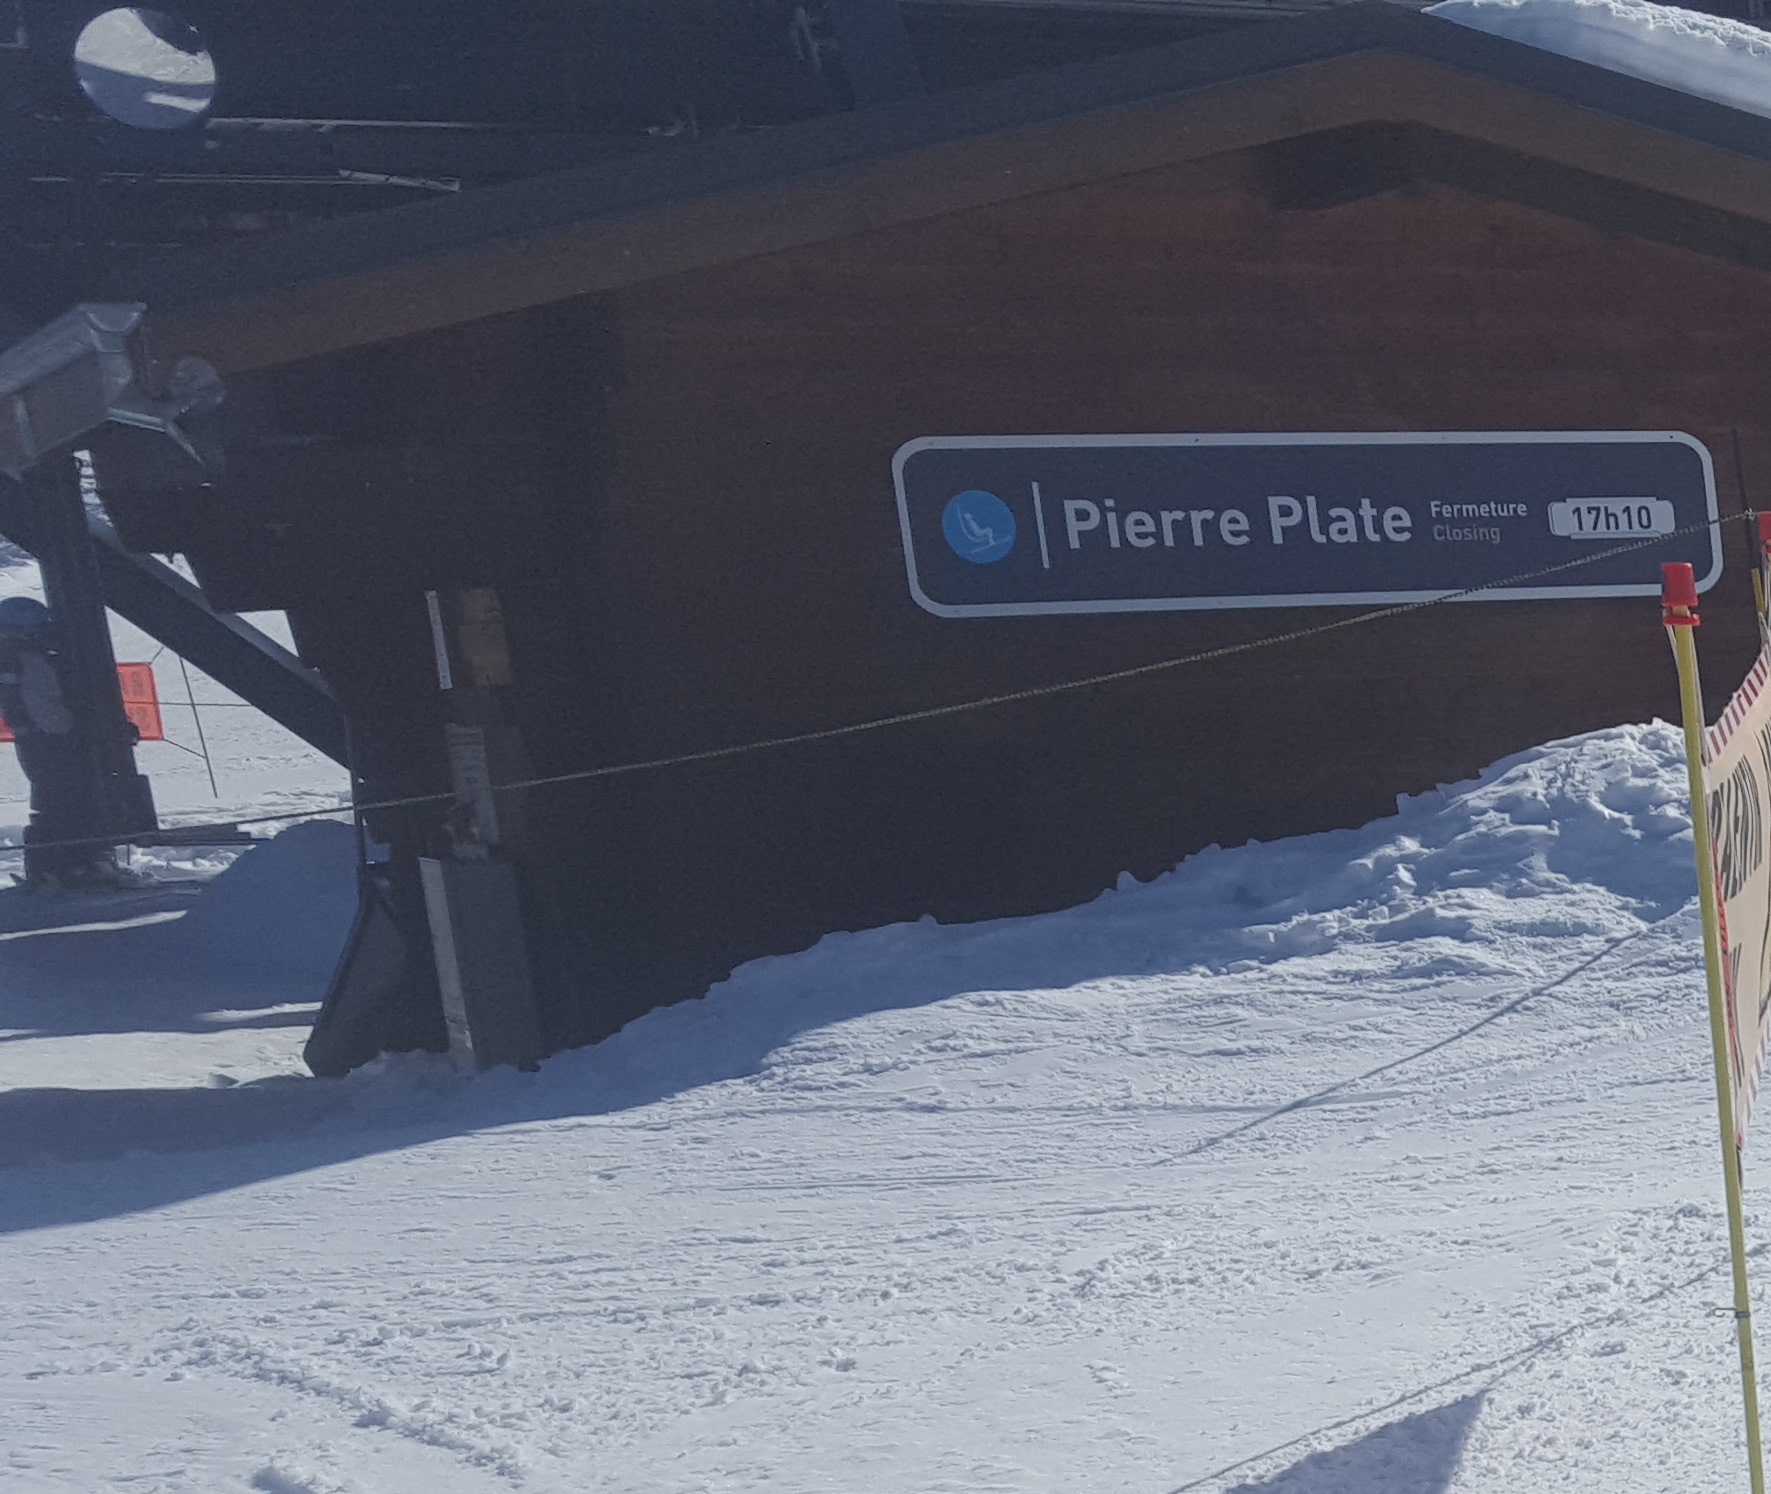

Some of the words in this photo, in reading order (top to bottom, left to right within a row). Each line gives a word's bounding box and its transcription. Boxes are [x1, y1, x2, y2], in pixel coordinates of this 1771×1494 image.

[1429, 500, 1528, 519] Fermeture
[1571, 504, 1652, 532] 17h10
[1062, 498, 1251, 550] Pierre
[1267, 495, 1414, 545] Plate
[1432, 523, 1501, 544] Closing
